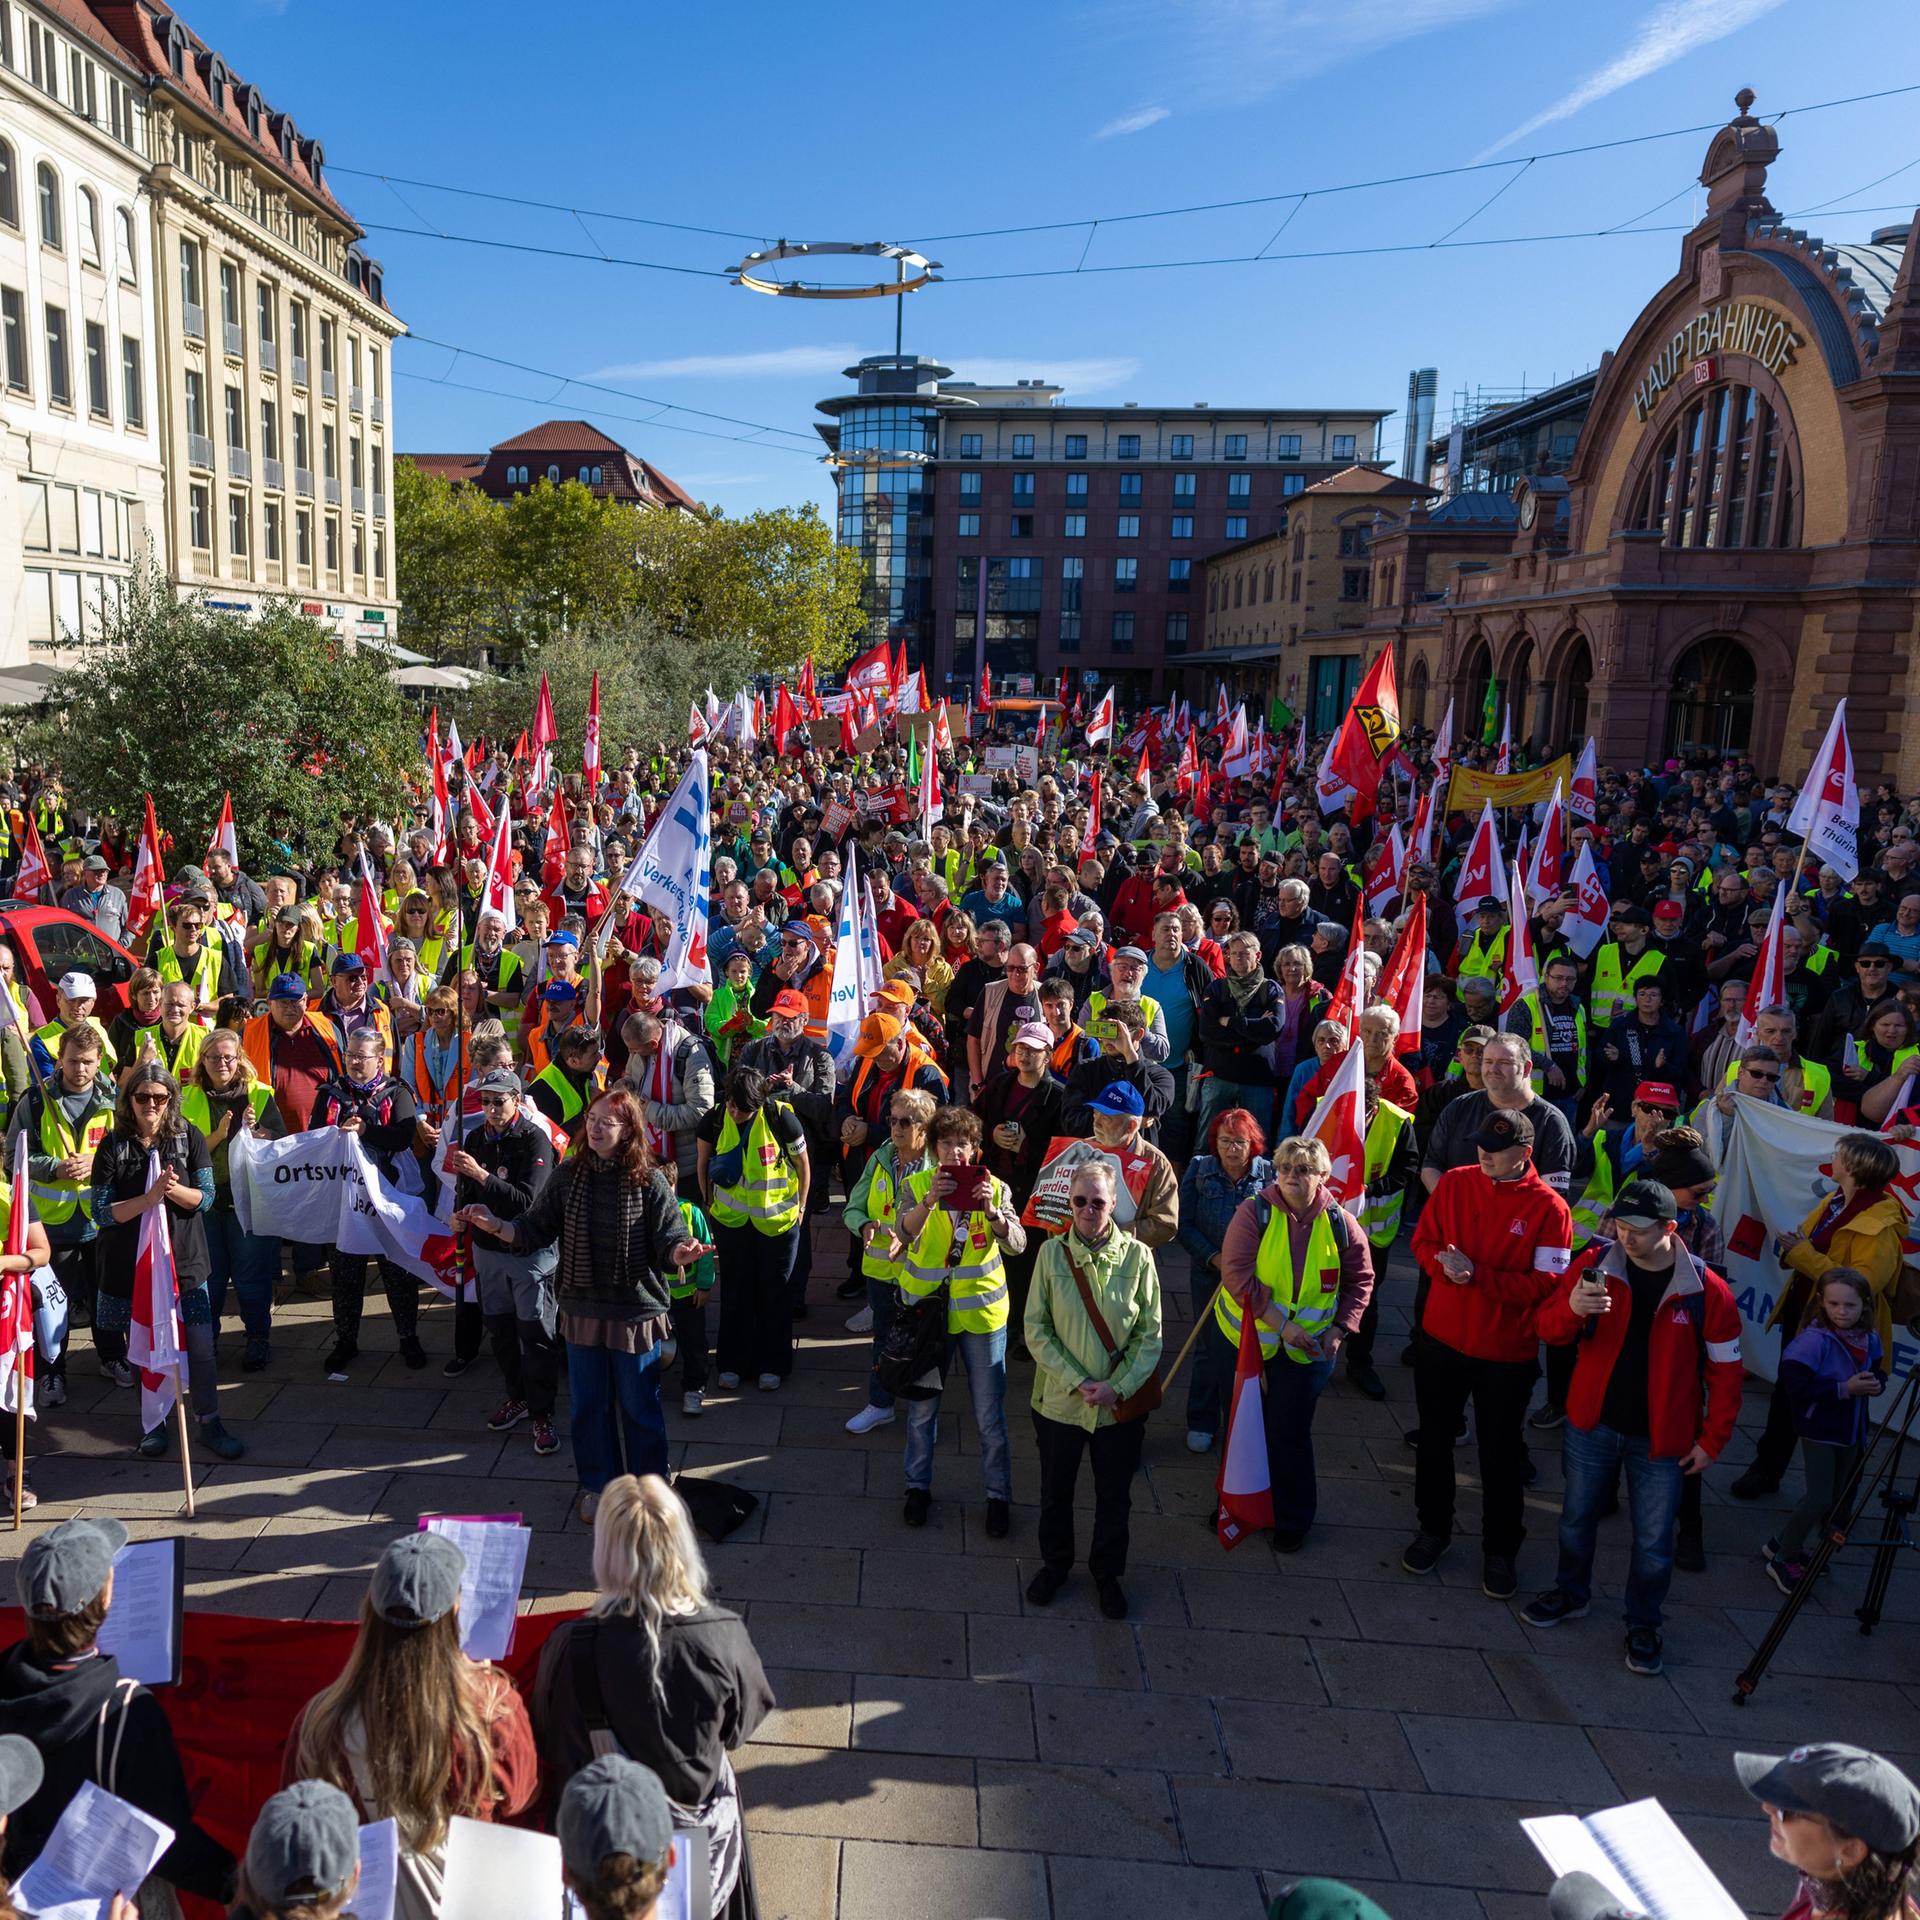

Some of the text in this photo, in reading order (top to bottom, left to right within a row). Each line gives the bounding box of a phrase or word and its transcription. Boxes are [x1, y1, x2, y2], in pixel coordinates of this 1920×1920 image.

[1633, 303, 1798, 422] HAUPTBAHNHOF
[1695, 365, 1708, 381] DB
[1108, 1092, 1122, 1103] EVG
